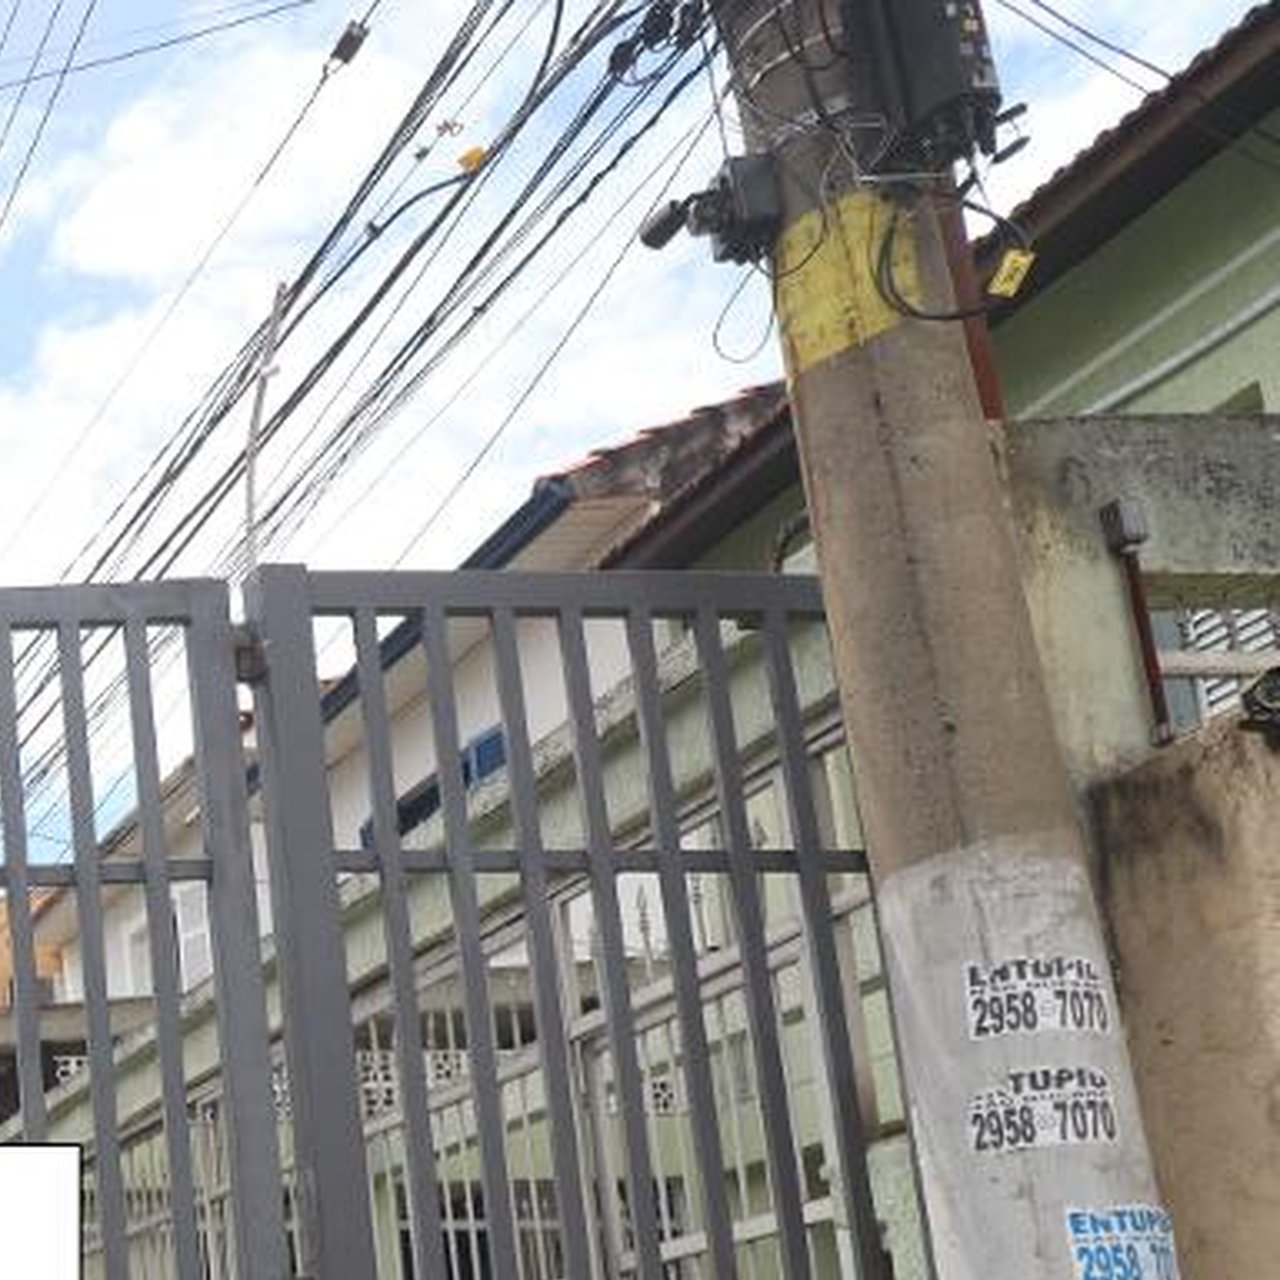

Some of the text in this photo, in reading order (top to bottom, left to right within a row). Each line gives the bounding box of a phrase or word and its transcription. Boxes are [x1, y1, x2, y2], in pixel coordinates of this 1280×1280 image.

[972, 989, 1108, 1037] 2958 7070
[971, 1100, 1117, 1151] 2958 7070
